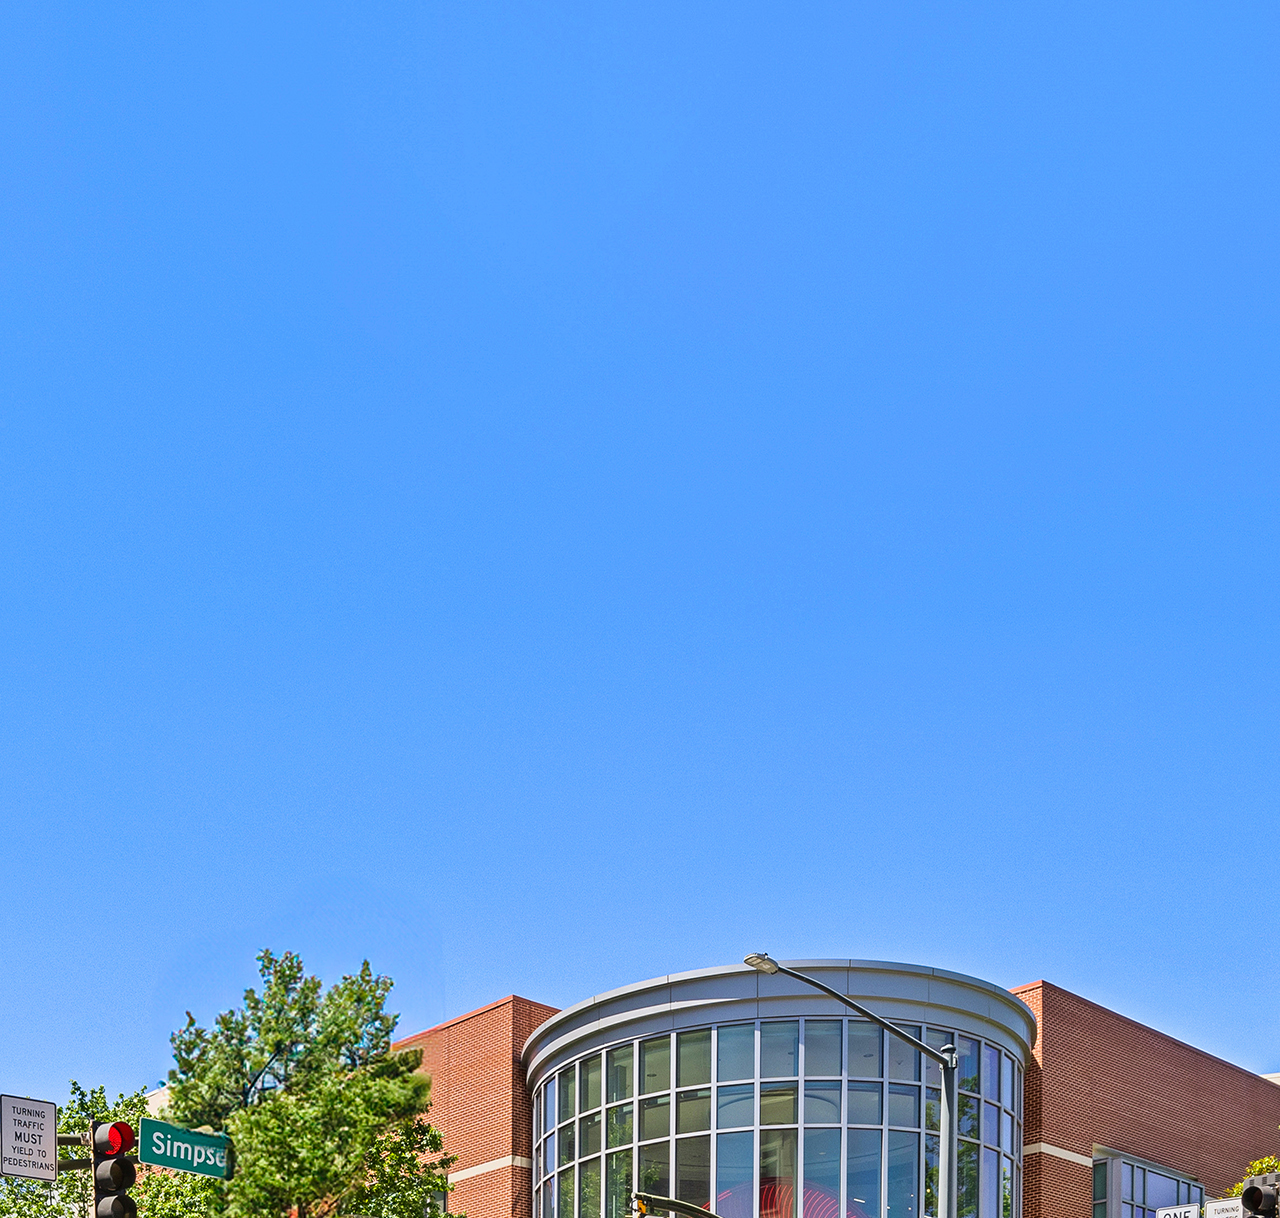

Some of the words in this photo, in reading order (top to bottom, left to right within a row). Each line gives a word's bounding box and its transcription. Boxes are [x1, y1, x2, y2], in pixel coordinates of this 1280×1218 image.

[11, 1105, 46, 1119] TURNING
[13, 1118, 45, 1131] TRAFFIC
[14, 1131, 43, 1145] MUST
[11, 1145, 34, 1156] YIELD
[37, 1149, 47, 1159] TO
[3, 1156, 55, 1172] PEDESTRIANS
[1213, 1205, 1240, 1215] TURNING
